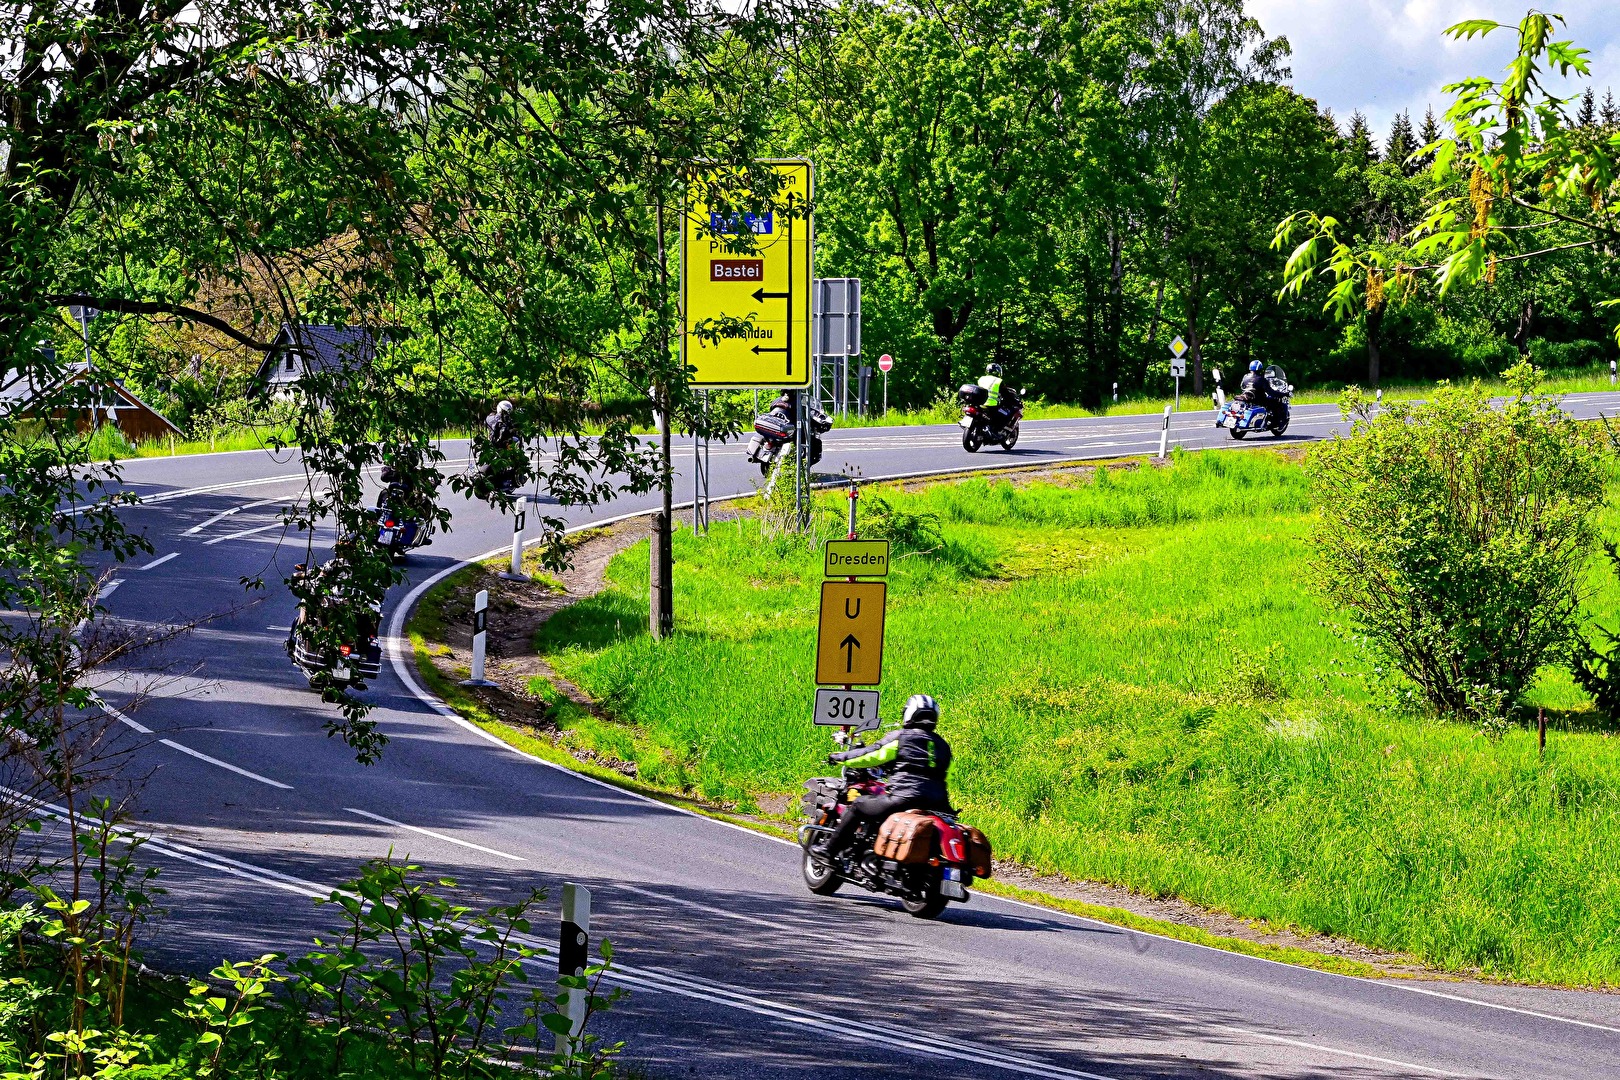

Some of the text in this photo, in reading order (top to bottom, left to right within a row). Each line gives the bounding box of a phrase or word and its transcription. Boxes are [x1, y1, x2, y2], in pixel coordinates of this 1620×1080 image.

[714, 263, 759, 277] Bastei
[829, 552, 885, 565] Dresden
[845, 597, 861, 620] U
